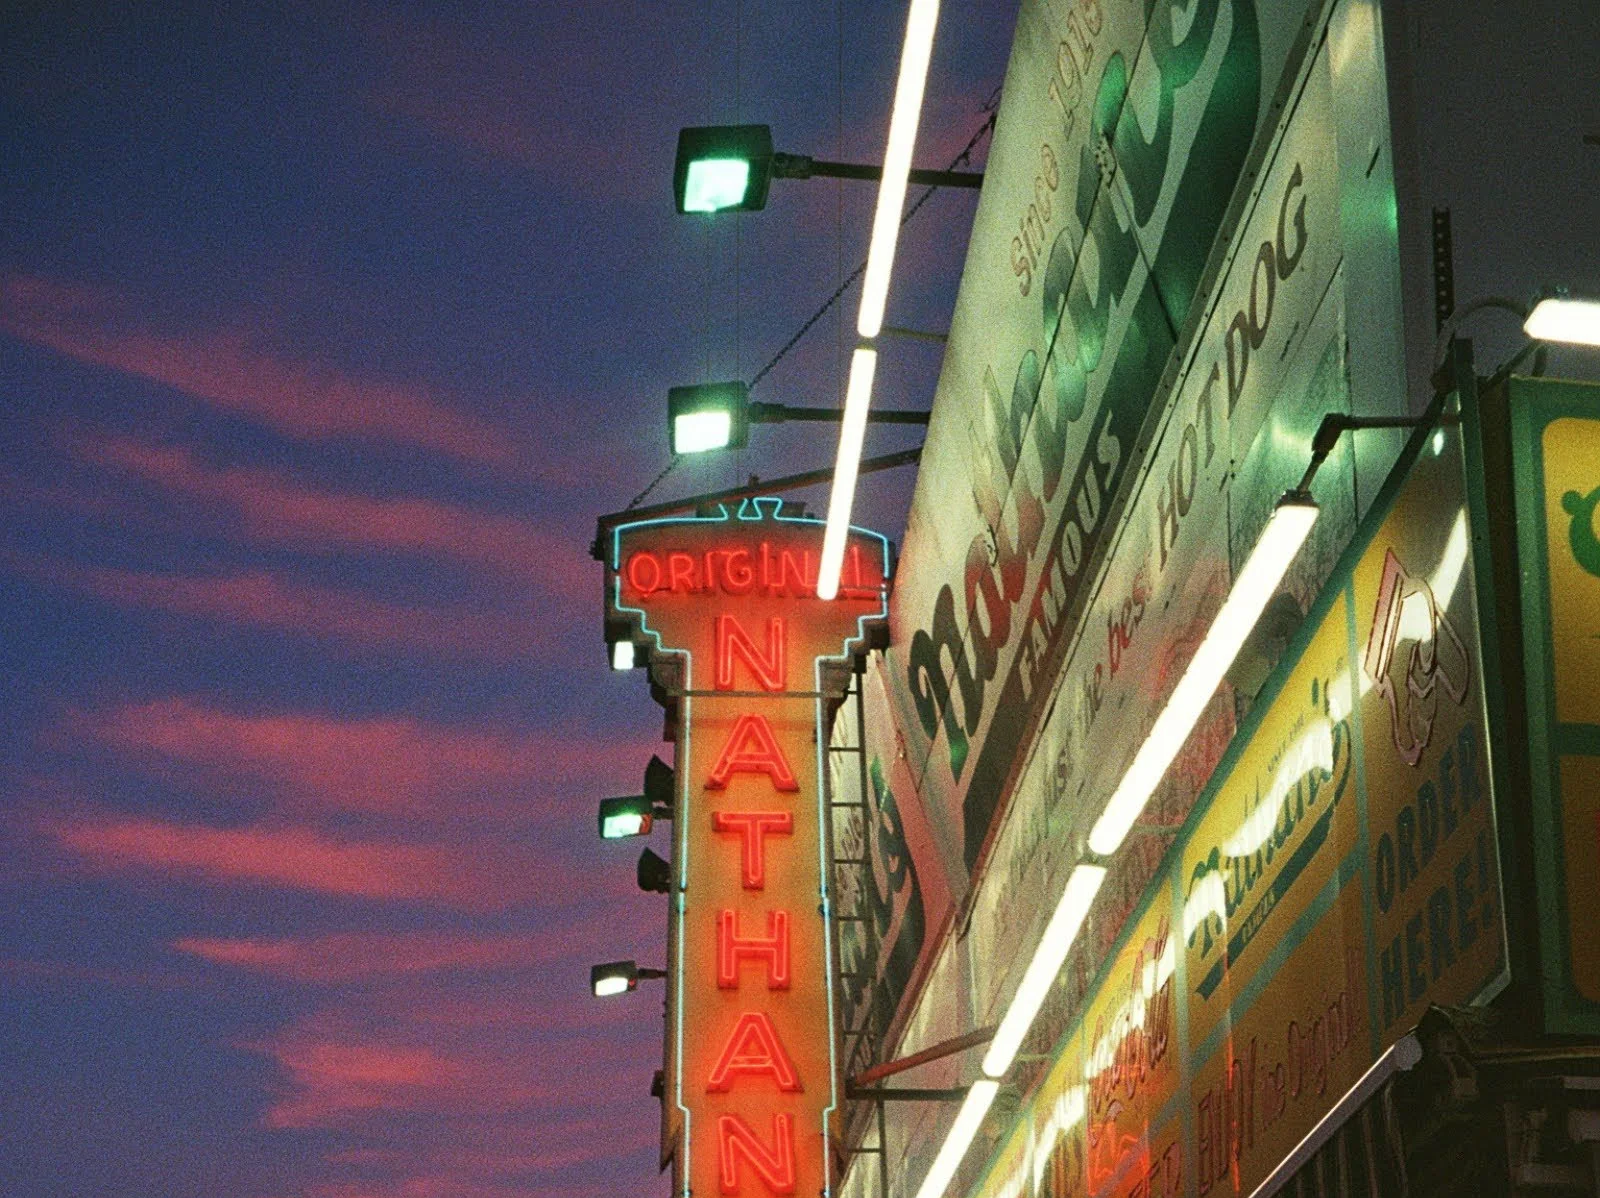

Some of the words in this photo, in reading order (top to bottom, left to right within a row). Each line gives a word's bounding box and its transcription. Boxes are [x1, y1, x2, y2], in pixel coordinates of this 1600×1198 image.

[627, 541, 878, 600] ORIGINL
[1018, 408, 1121, 702] FAMOUS
[1375, 720, 1482, 914] ORDER
[1380, 829, 1493, 1032] HERE!
